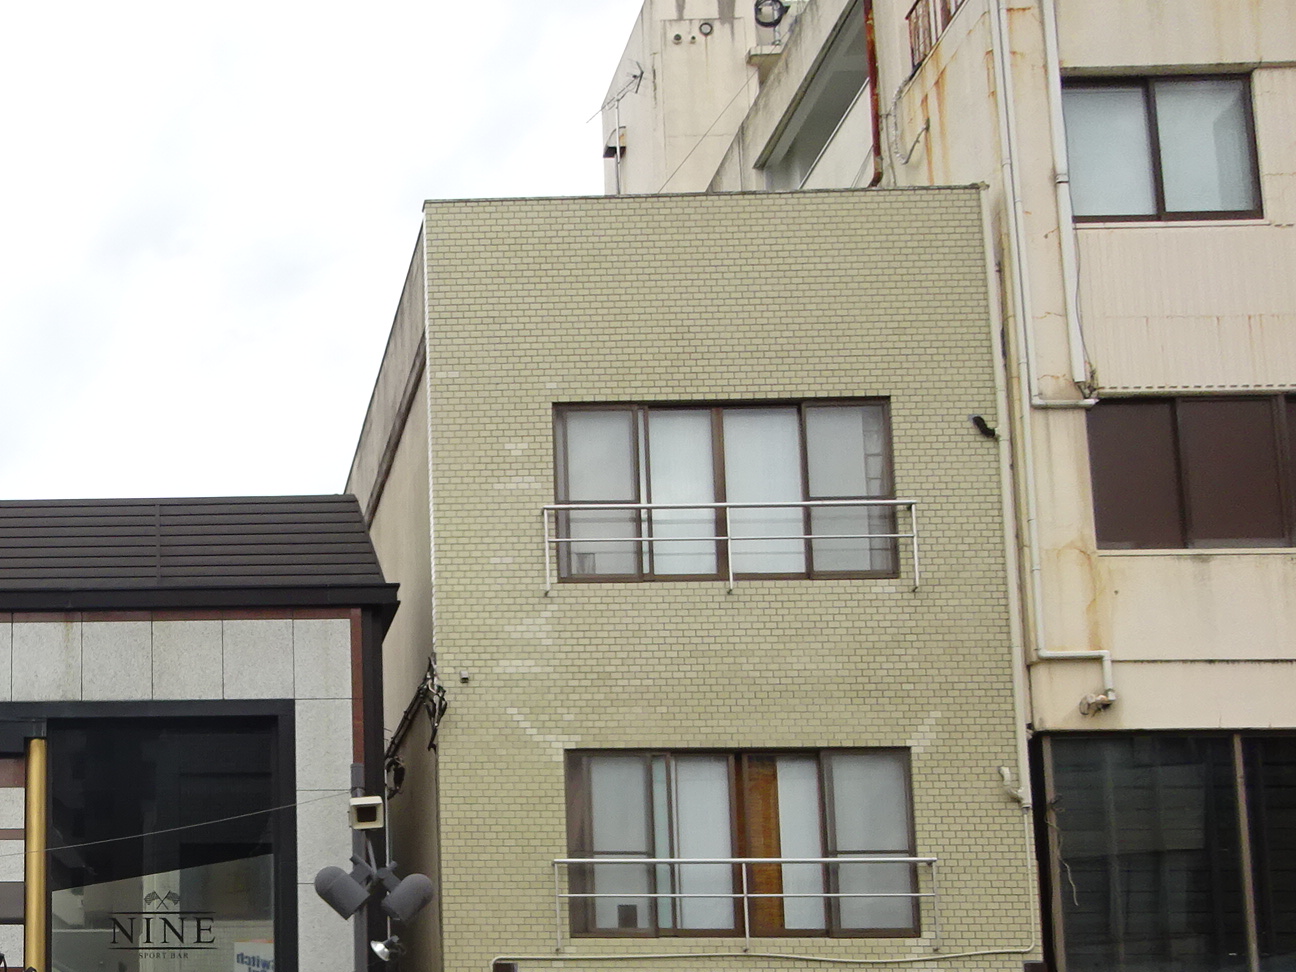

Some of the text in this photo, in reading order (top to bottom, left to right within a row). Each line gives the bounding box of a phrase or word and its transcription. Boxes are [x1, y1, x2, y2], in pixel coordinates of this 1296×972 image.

[109, 917, 216, 944] NINE
[138, 952, 189, 960] SPORT BAR
